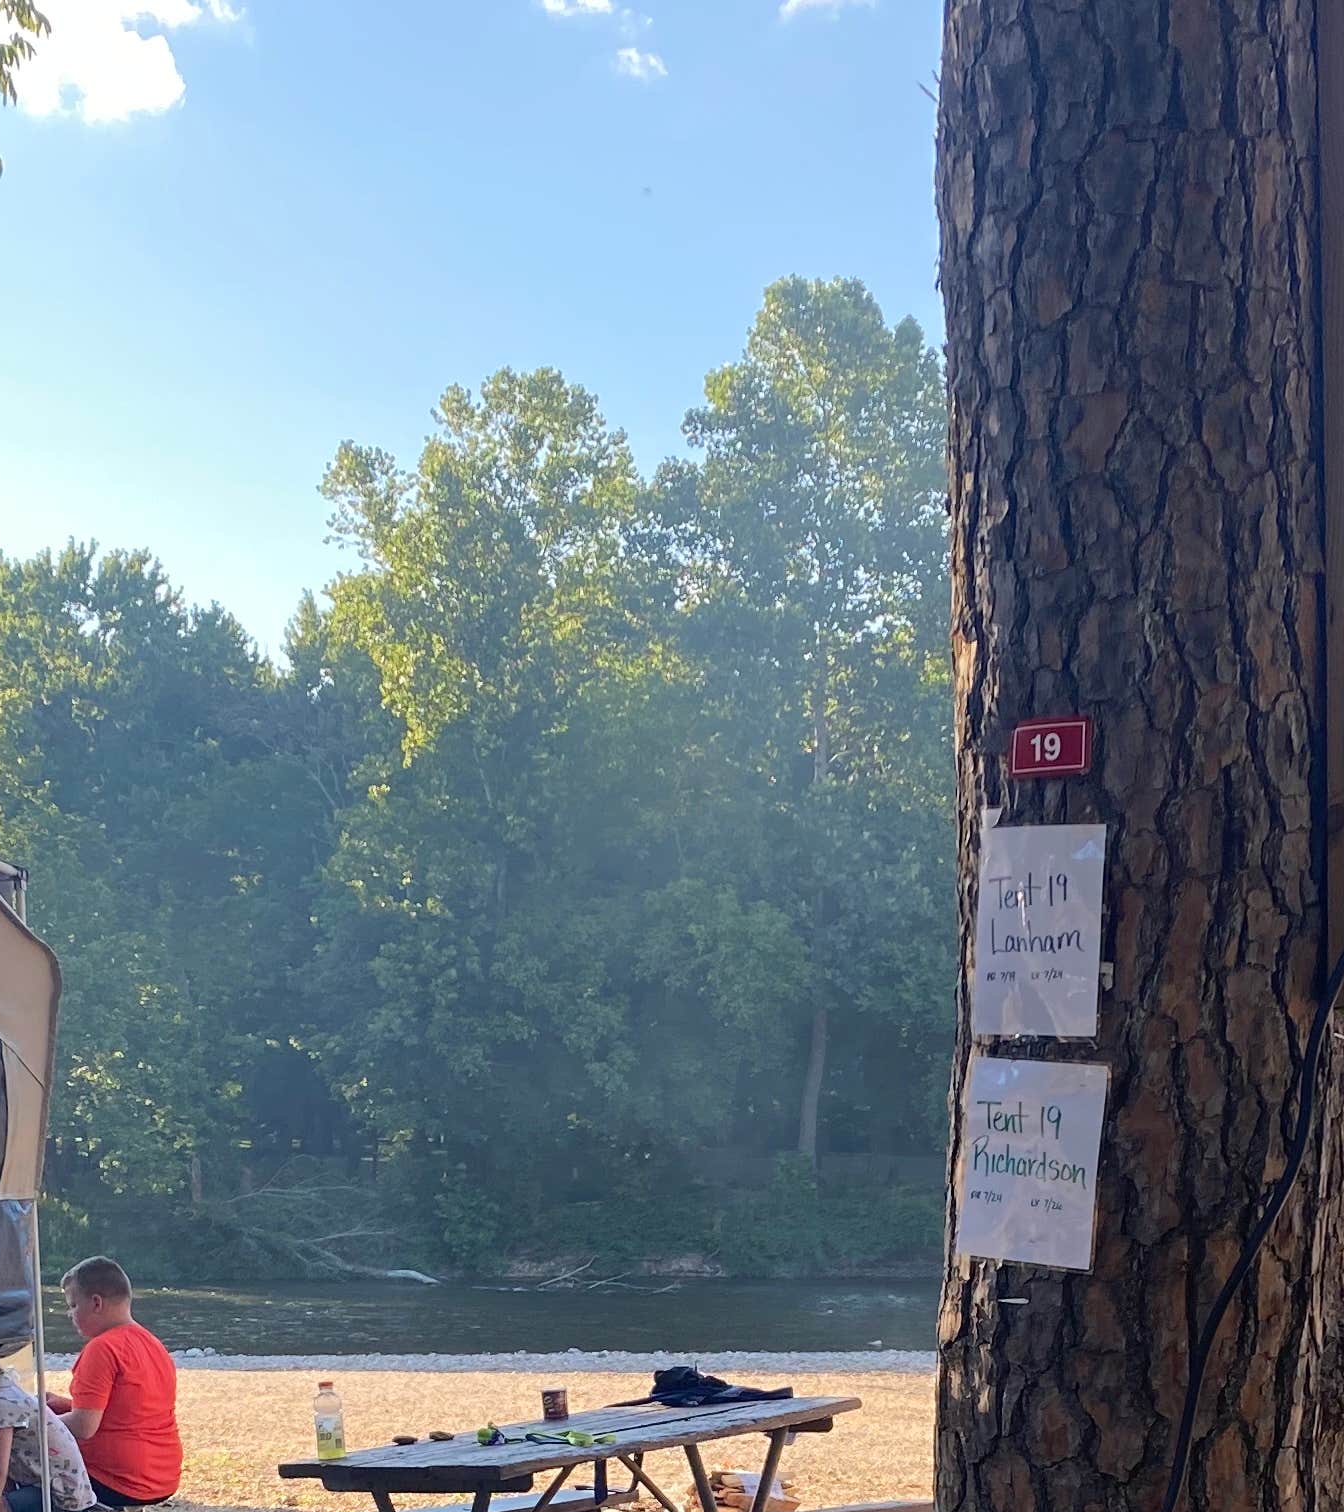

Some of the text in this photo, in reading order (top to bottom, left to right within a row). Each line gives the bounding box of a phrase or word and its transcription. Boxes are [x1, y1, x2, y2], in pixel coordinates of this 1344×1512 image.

[1030, 732, 1061, 762] 19
[989, 872, 1067, 909] Tent 19
[991, 918, 1085, 955] Lanham
[977, 1101, 1061, 1140] Tent 19
[972, 1134, 1086, 1190] Richardson
